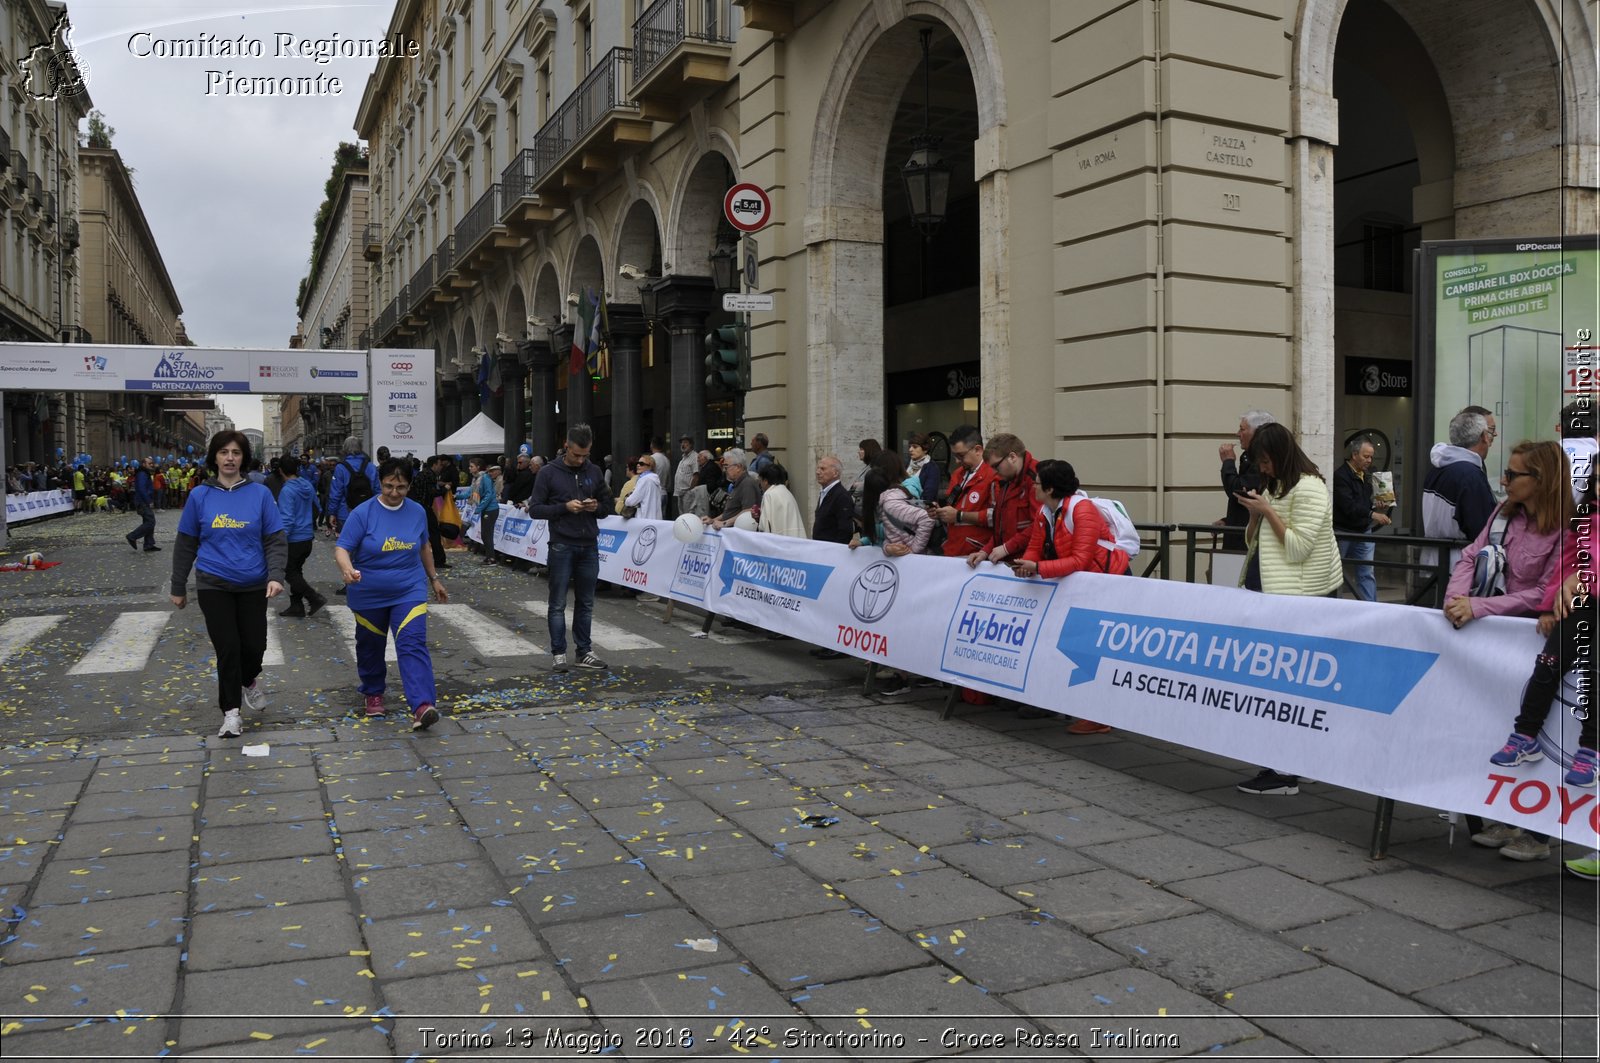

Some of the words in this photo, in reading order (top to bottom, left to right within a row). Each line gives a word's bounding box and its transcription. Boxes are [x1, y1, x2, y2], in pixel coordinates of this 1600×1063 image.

[1213, 136, 1246, 150] PIAZZA
[1078, 158, 1092, 170] VIA
[1094, 150, 1117, 166] ROMA
[1206, 151, 1254, 168] CASTELLO
[1516, 243, 1562, 251] IGPDecaux
[1444, 267, 1478, 279] CONSIGLIO
[1445, 277, 1497, 296] CAMBIARE
[1499, 275, 1508, 286] IL
[1509, 271, 1531, 284] BOX
[1464, 293, 1497, 308] PRIMA
[1498, 289, 1519, 301] CHE
[1521, 282, 1553, 297] ABBIA
[1472, 307, 1489, 321] PIÙ
[1490, 303, 1517, 318] ANNI
[1518, 302, 1529, 313] DI
[1530, 299, 1547, 310] TE.
[173, 361, 198, 370] STRA
[174, 370, 215, 379] TORINO
[151, 382, 224, 390] PARTENZA/ARRIVO
[959, 376, 980, 390] Store
[1381, 372, 1407, 388] Store
[681, 554, 711, 575] Hybrid
[732, 556, 769, 581] TOYOTA
[768, 565, 807, 590] HYBRID.
[623, 568, 648, 586] TOYOTA
[736, 585, 744, 596] LA
[744, 587, 763, 601] SCELTA
[762, 591, 801, 612] INEVITABILE.
[970, 590, 986, 602] 50%
[986, 593, 996, 602] IN
[996, 594, 1039, 609] ELETTRICO
[958, 610, 1031, 646] Hybrid
[836, 624, 888, 657] TOYOTA
[953, 645, 1019, 670] AUTORICARICABILE
[1096, 619, 1198, 665] TOYOTA
[1204, 635, 1342, 692] HYBRID.
[1112, 668, 1132, 689] LA
[1135, 673, 1197, 702] SCELTA
[1201, 686, 1329, 732] INEVITABILE.
[1484, 773, 1600, 837] TOY
